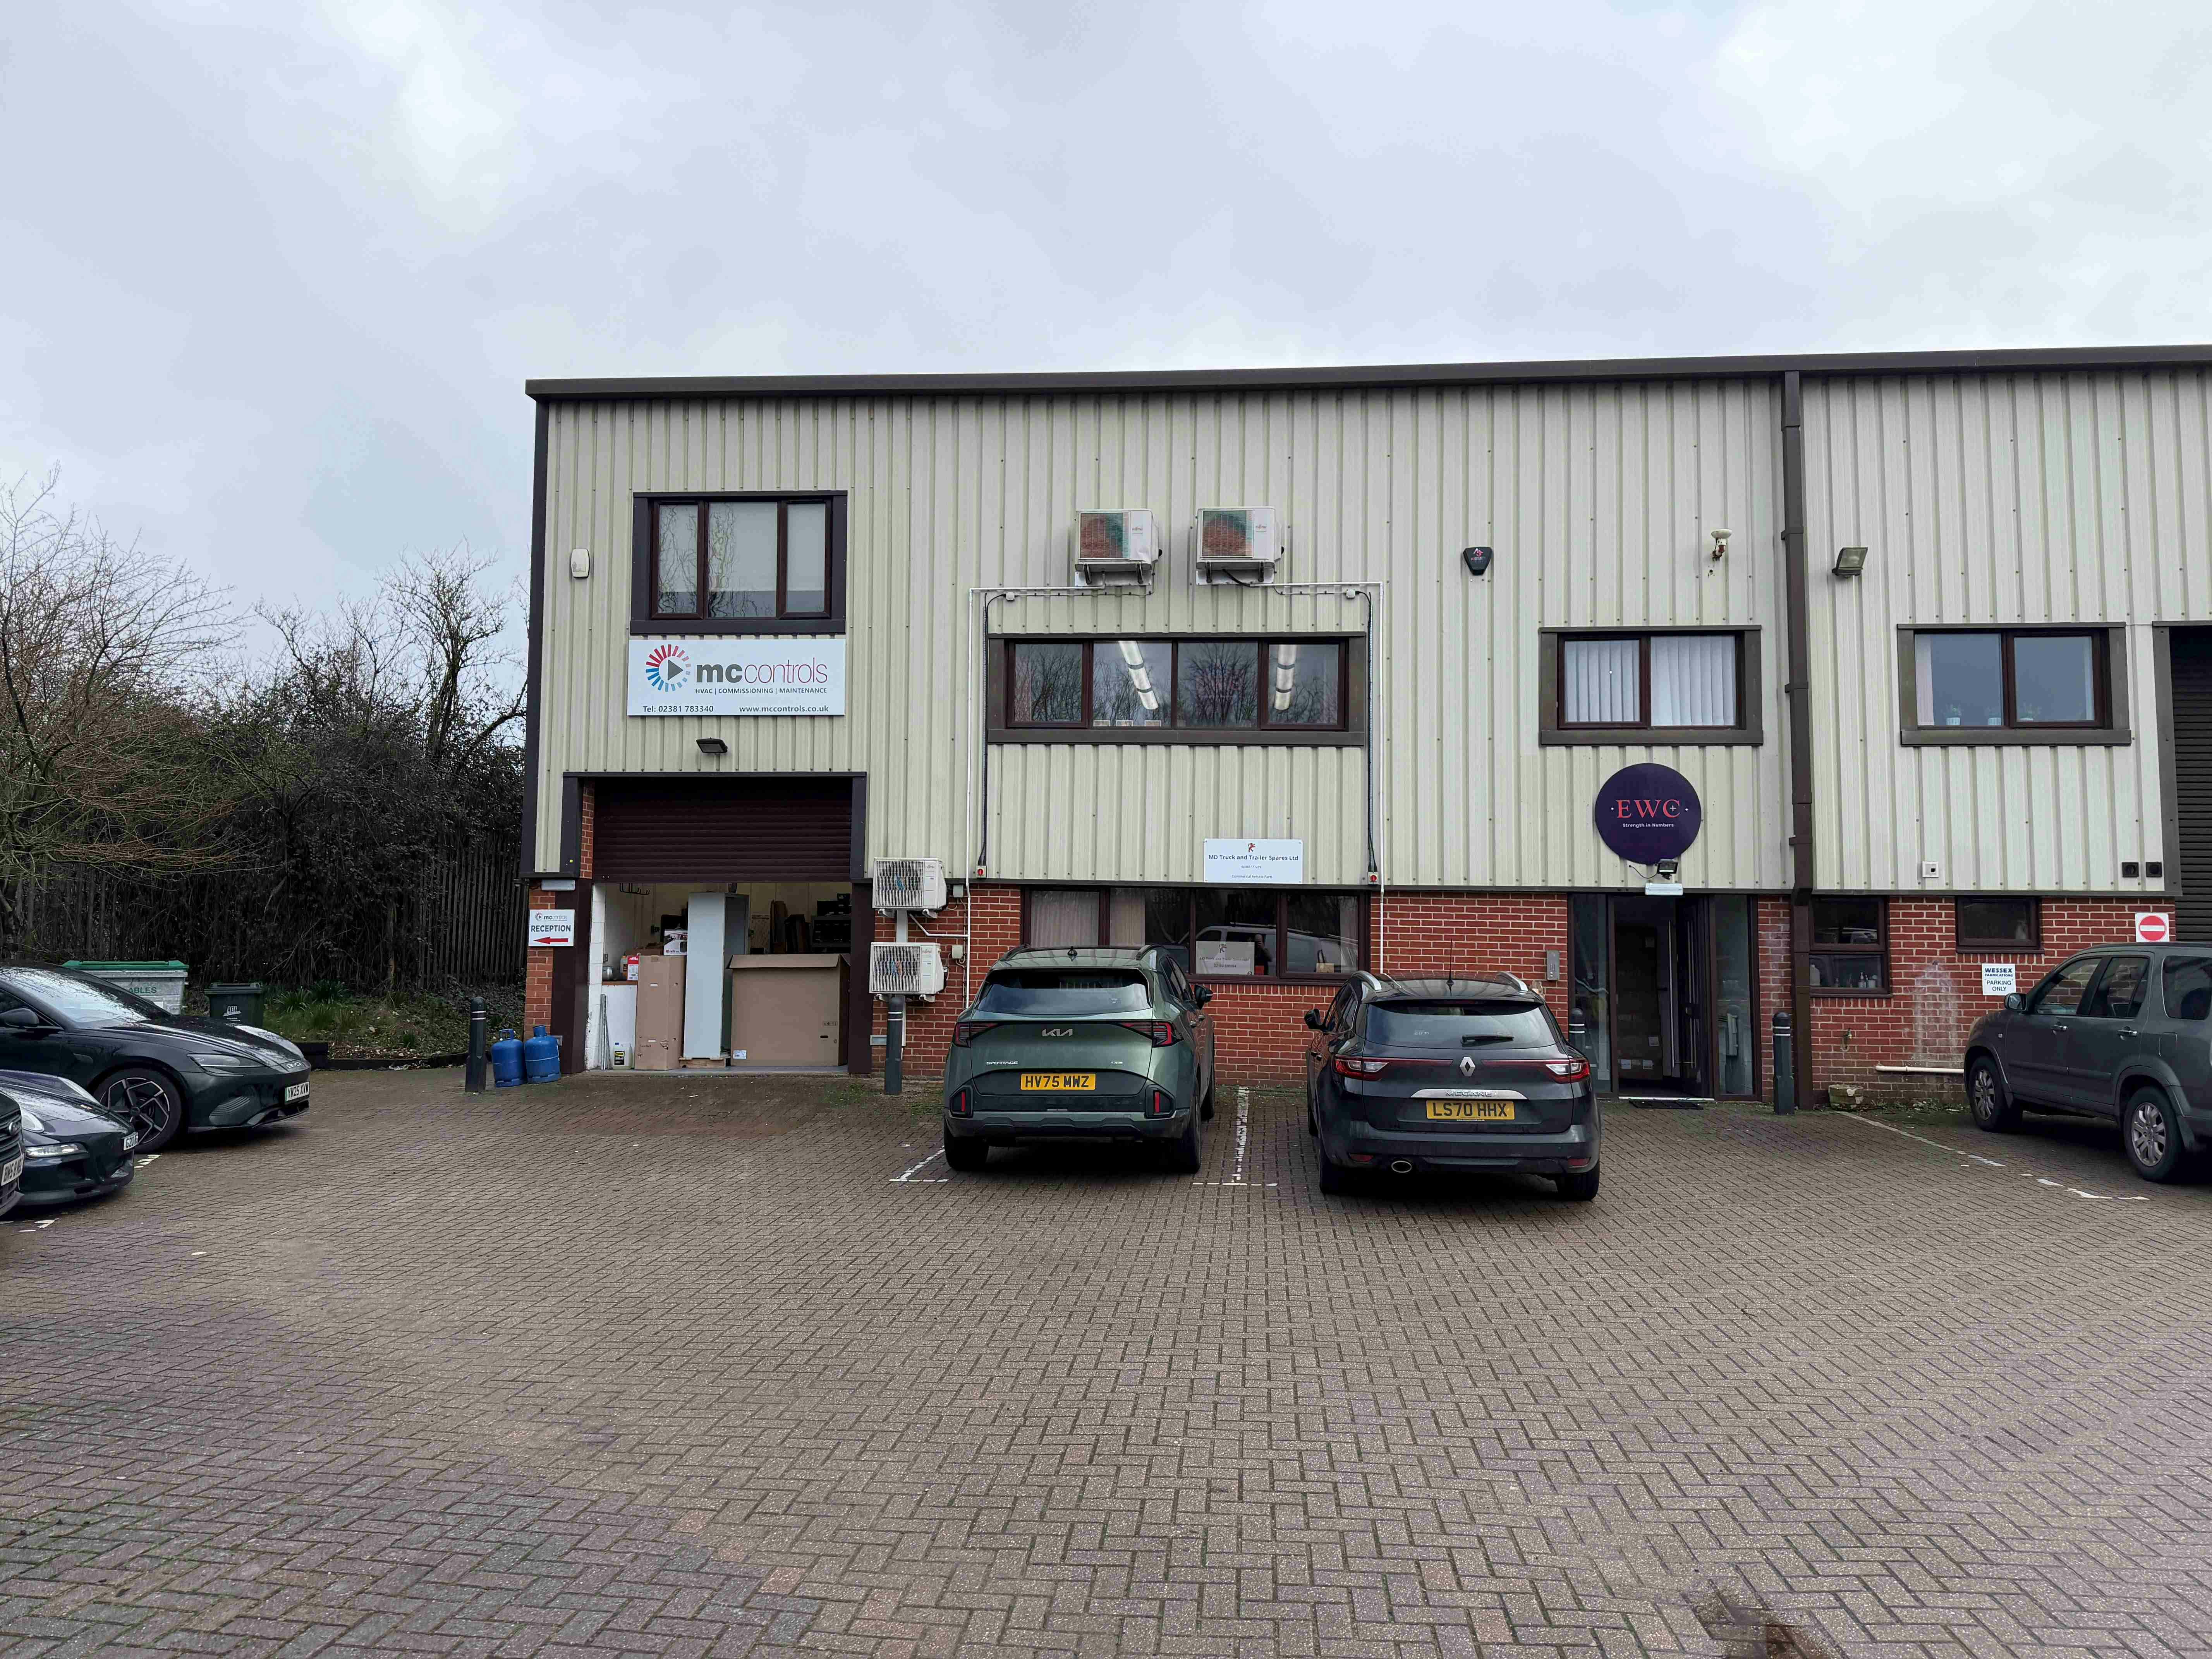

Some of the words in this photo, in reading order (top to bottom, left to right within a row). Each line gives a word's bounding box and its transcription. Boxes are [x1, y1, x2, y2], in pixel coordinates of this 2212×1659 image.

[1025, 1075, 1060, 1088] HV75
[1063, 1075, 1089, 1088] MWZ
[1433, 1103, 1473, 1116] LS70
[1477, 1103, 1507, 1117] HHX
